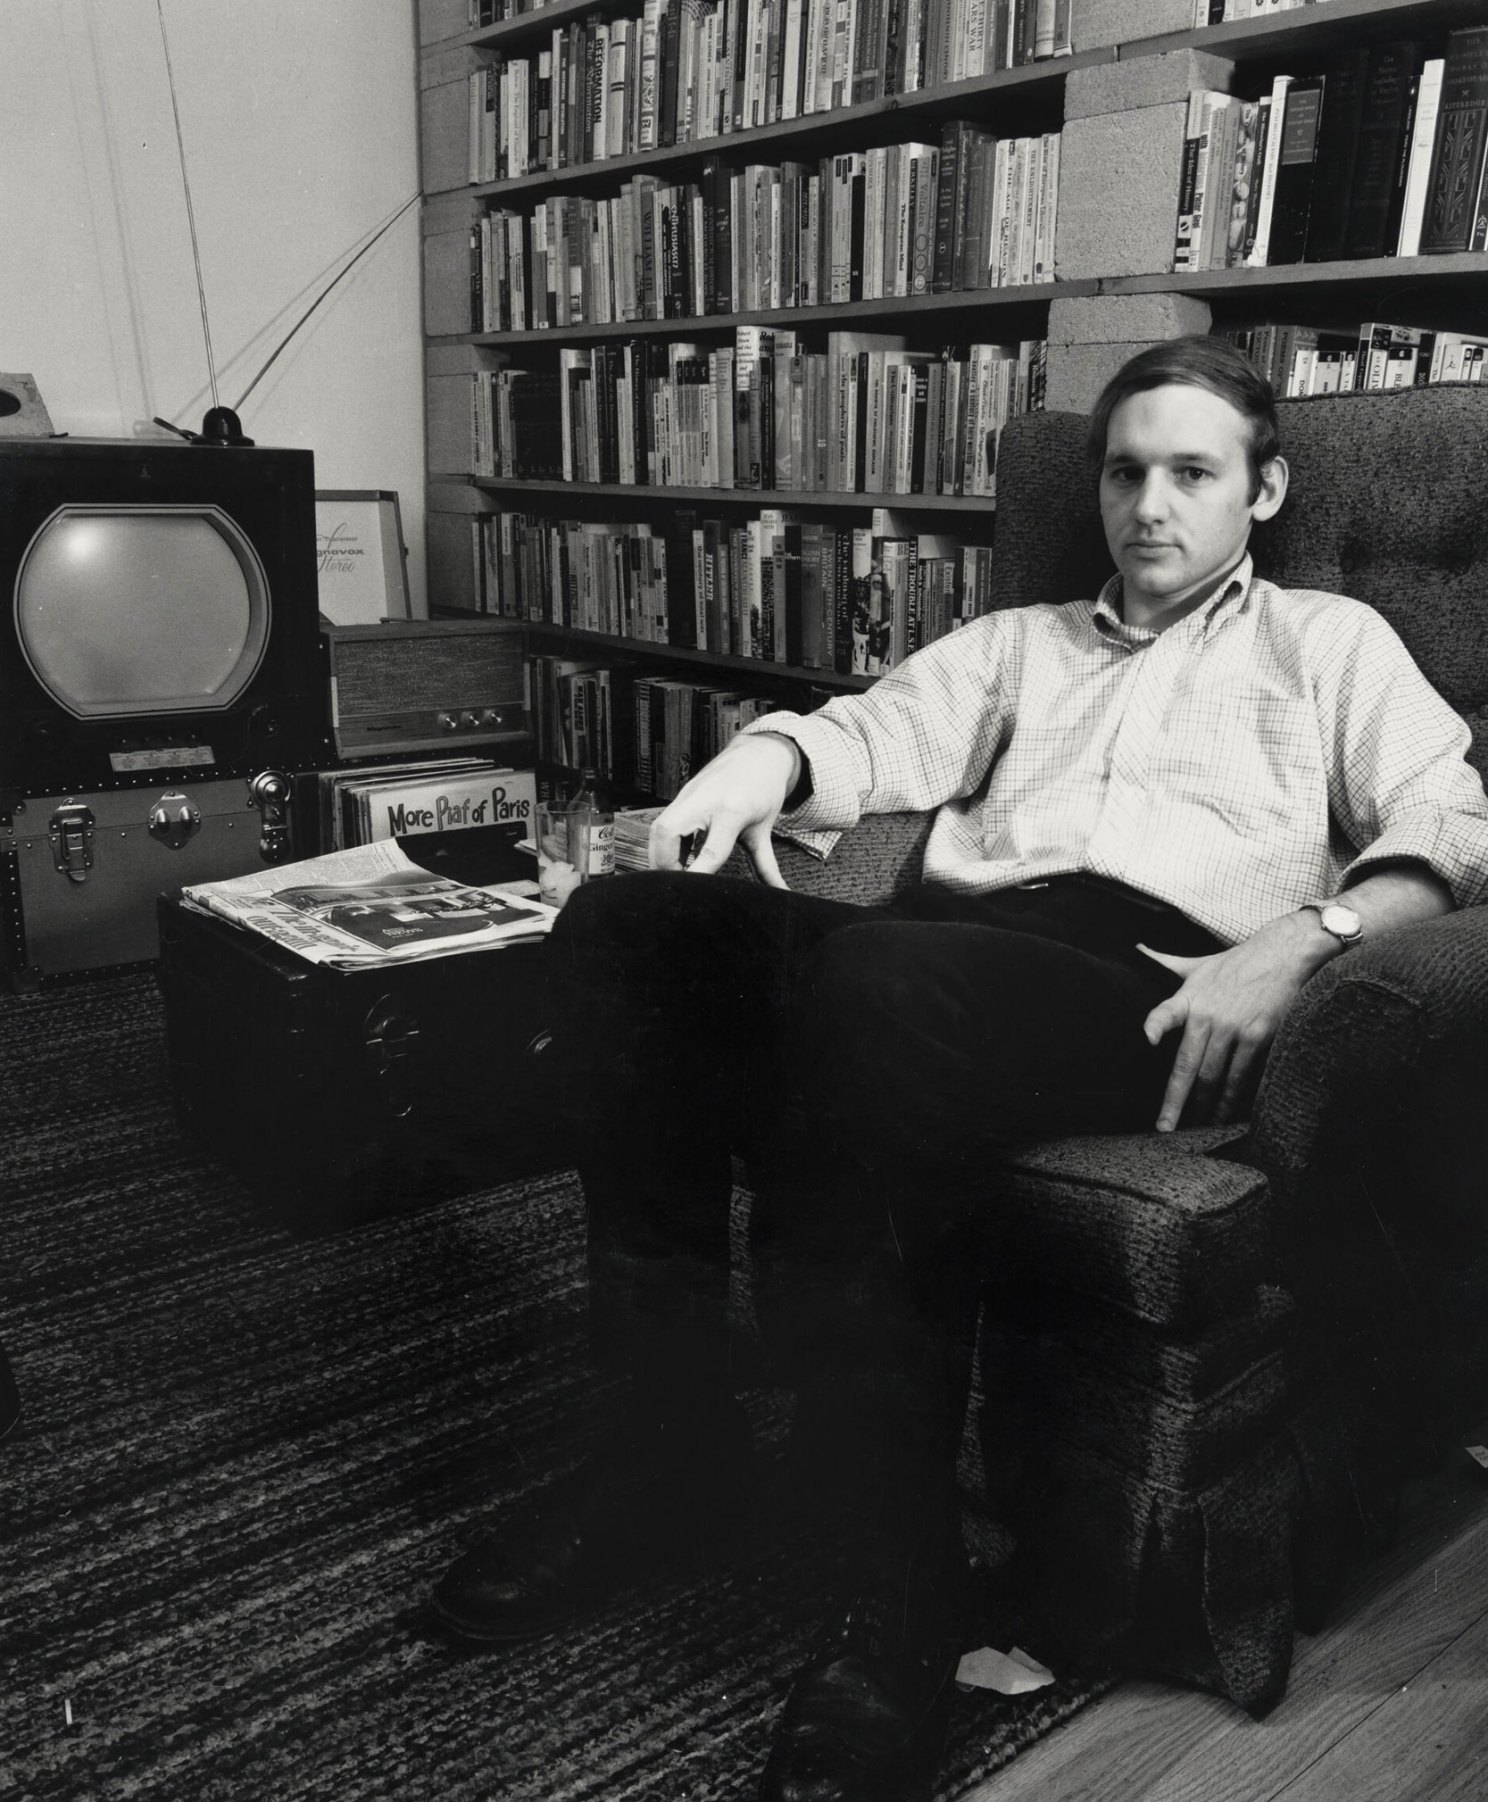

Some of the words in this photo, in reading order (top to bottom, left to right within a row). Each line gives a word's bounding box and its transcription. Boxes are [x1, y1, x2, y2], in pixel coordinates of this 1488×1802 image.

[968, 28, 977, 52] WAR
[976, 11, 985, 50] THIRTY
[586, 41, 594, 60] The
[593, 38, 603, 123] REFORMATION
[585, 66, 594, 133] Reformation
[1445, 100, 1486, 109] KITTREDGE
[1188, 143, 1196, 156] The
[1200, 135, 1208, 149] with
[918, 183, 928, 227] Voltaire
[1026, 167, 1035, 227] ENLIGHTENMENT
[1183, 186, 1192, 211] History
[1193, 192, 1203, 212] Pieter
[643, 211, 652, 271] WILLIAM
[645, 277, 653, 291] III
[1280, 332, 1288, 363] POEMS
[1277, 366, 1283, 379] OF
[1371, 365, 1381, 390] OLIV
[839, 390, 847, 428] prophets
[967, 395, 976, 417] century
[840, 430, 846, 440] of
[909, 546, 917, 566] THE
[705, 554, 713, 601] HITLER
[908, 572, 917, 614] TROUBLE
[908, 616, 915, 627] AT
[907, 630, 915, 652] L.S.E.
[387, 803, 434, 836] More
[436, 796, 470, 831] Piaf
[472, 800, 488, 823] of
[492, 787, 530, 822] Paris
